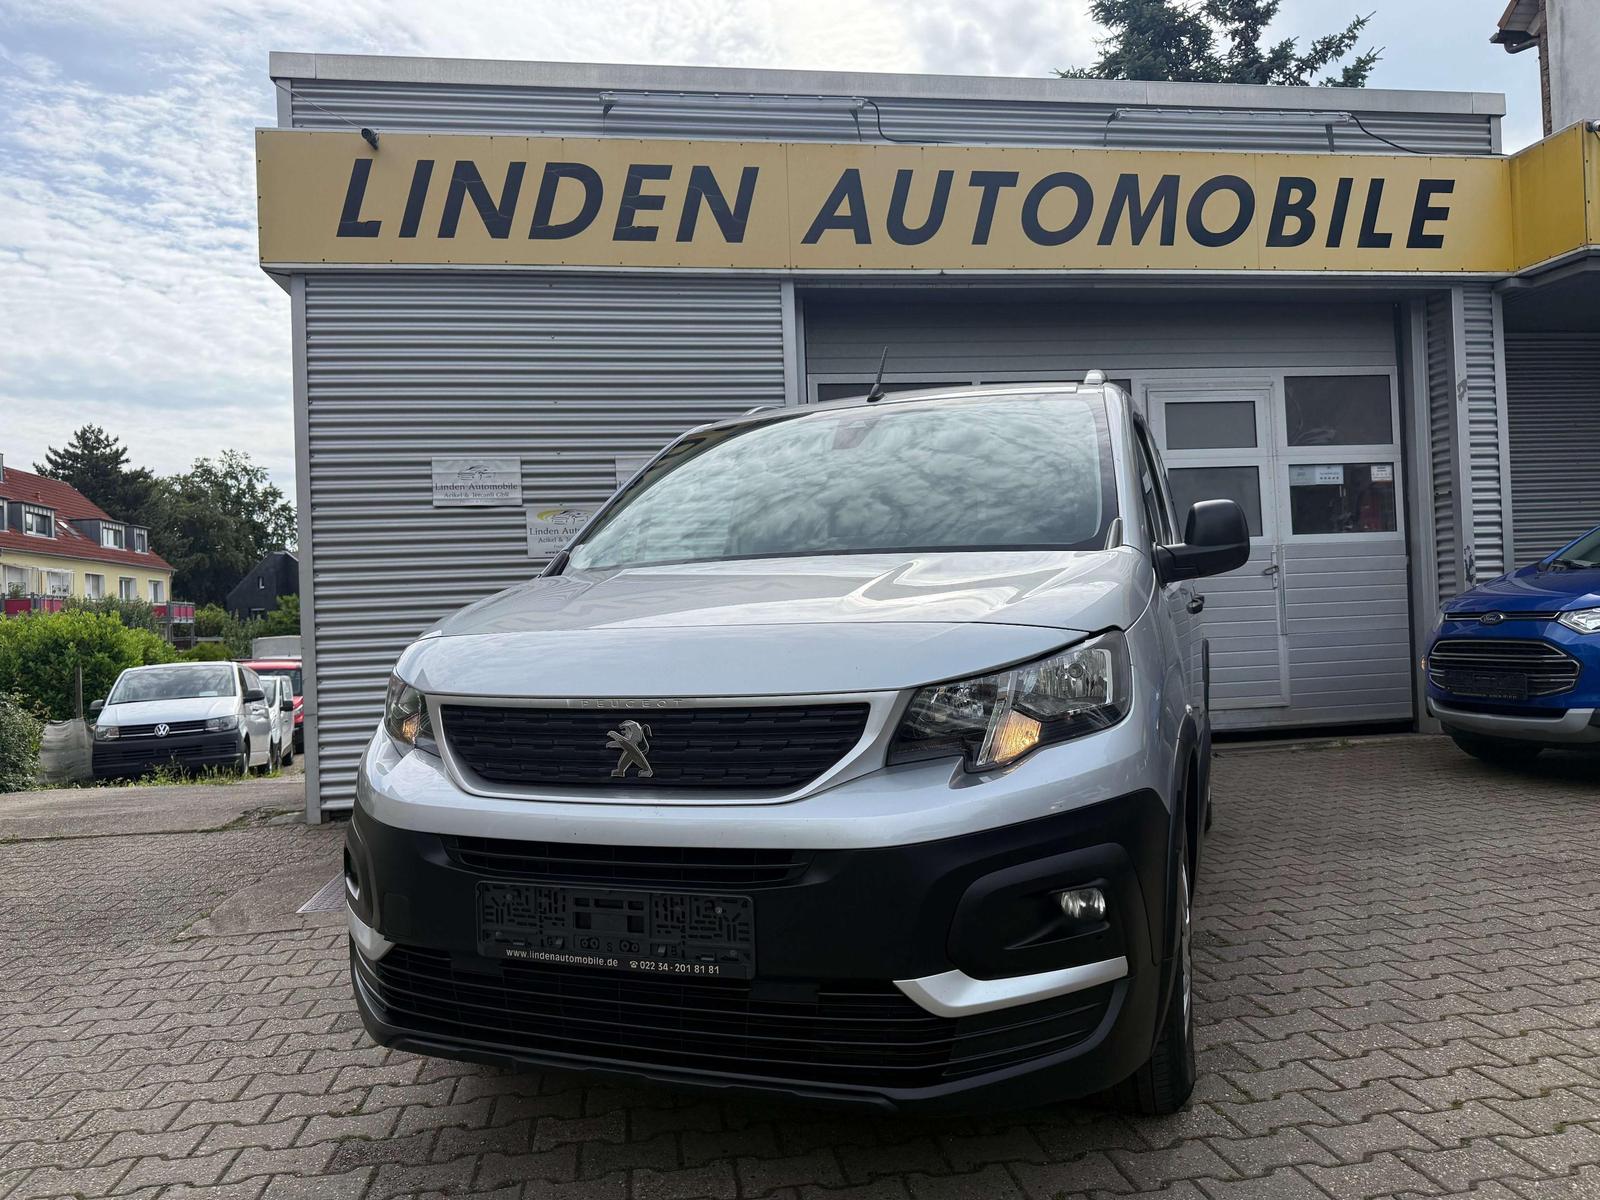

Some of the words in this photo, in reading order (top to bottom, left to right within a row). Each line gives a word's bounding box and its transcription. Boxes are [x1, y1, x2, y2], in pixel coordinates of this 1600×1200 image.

[336, 158, 760, 243] LINDEN
[801, 168, 1455, 248] AUTOMOBILE
[435, 482, 465, 491] Linden
[468, 482, 518, 491] Automobile
[529, 527, 559, 536] Linden
[581, 699, 684, 708] PEUGEOT
[506, 949, 619, 967] www.lindenautomobile.de
[639, 961, 656, 971] 022
[693, 964, 706, 974] 81
[708, 965, 720, 974] 81
